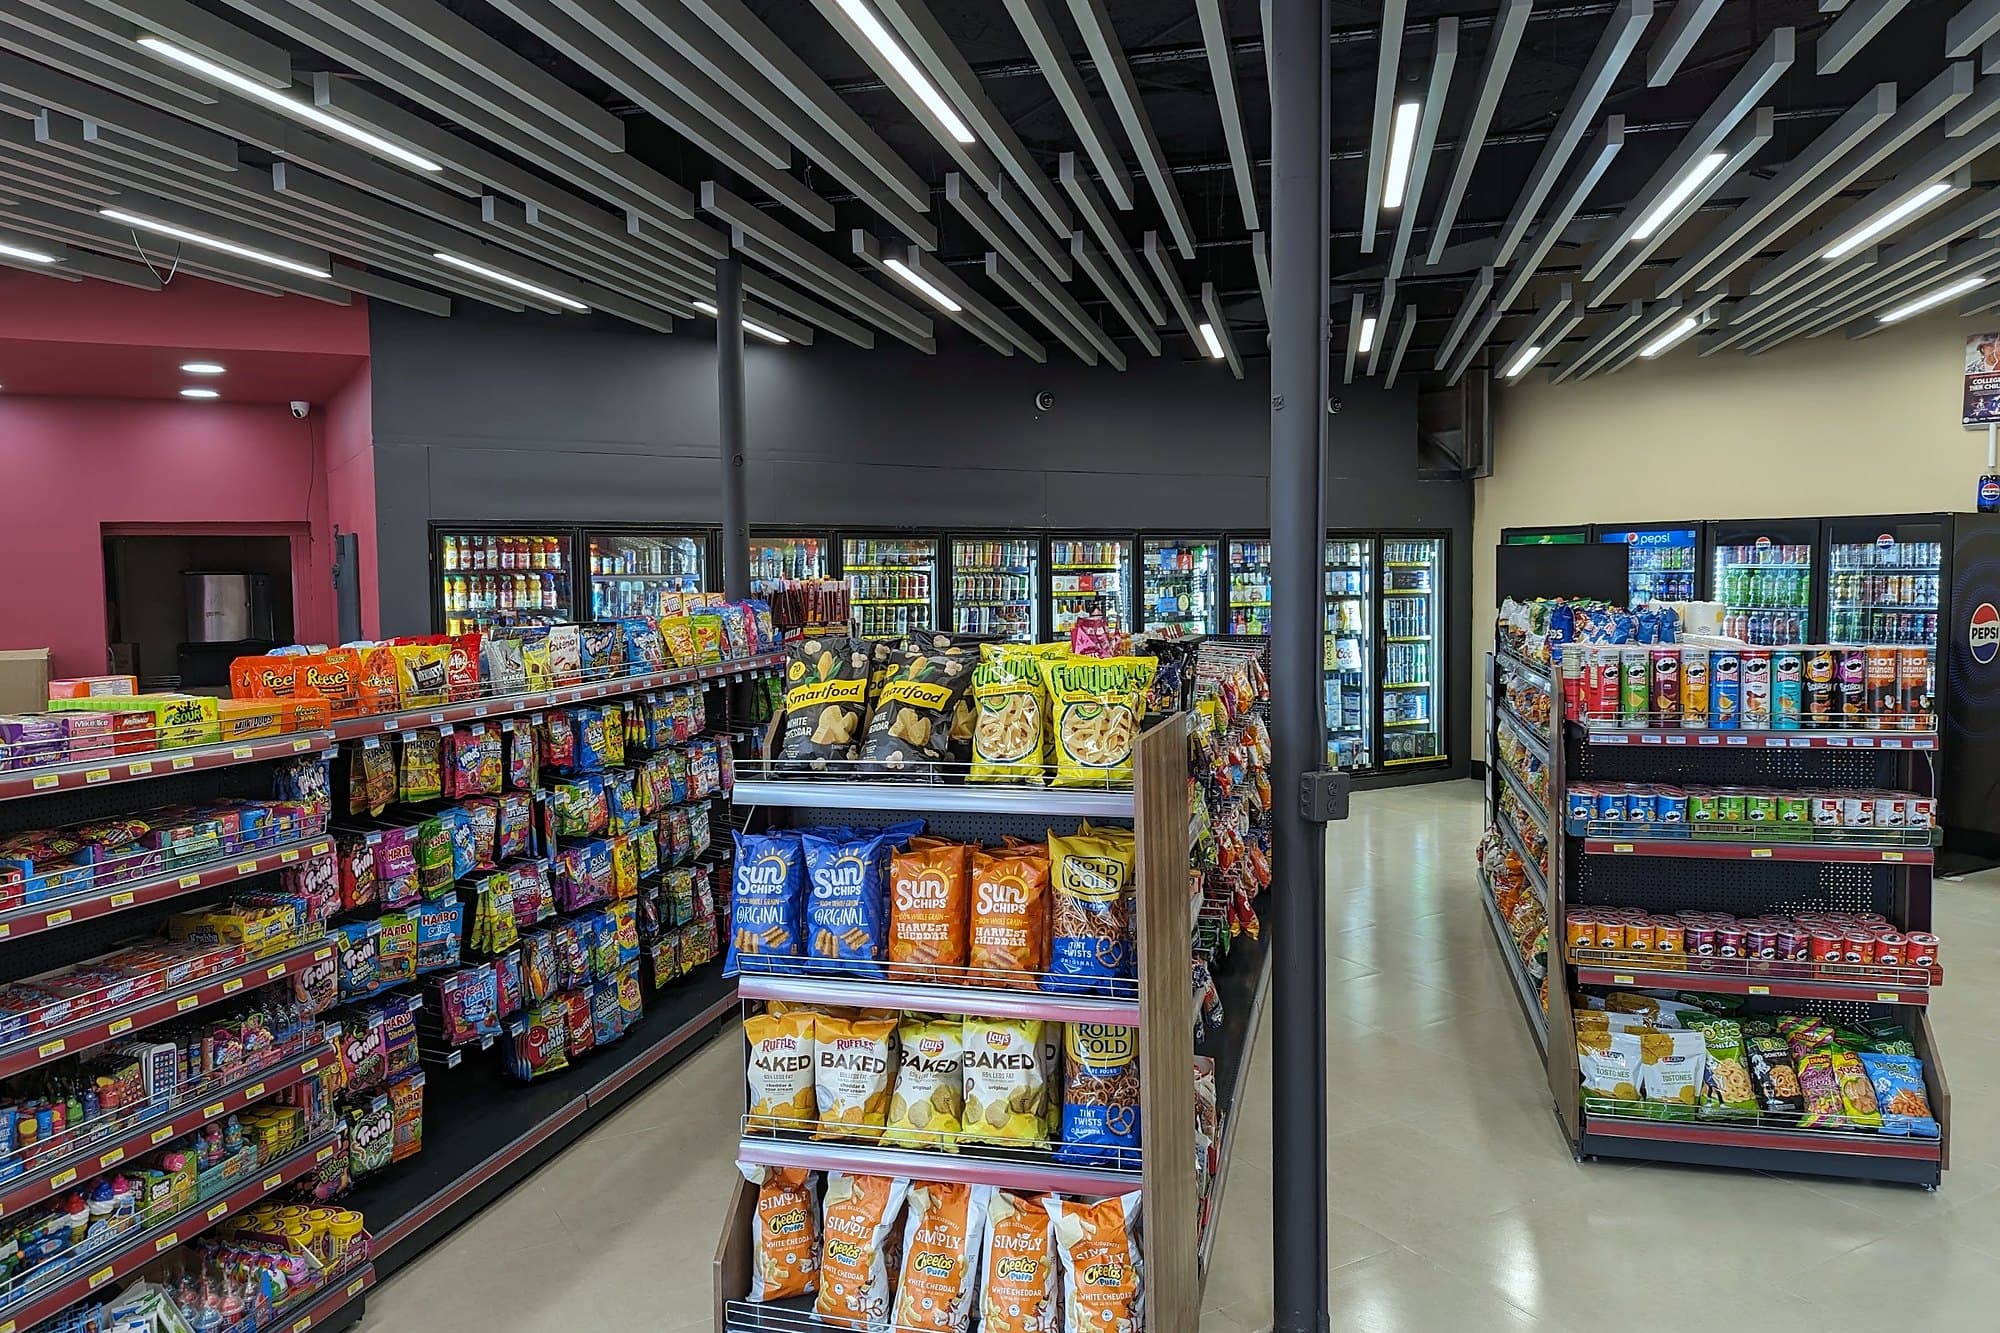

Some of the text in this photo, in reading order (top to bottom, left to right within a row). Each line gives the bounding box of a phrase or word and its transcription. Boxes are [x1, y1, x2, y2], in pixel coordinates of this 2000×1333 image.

[1641, 532, 1670, 545] pepsi
[1972, 627, 1999, 640] PEPSI
[788, 684, 860, 709] Smartfood
[174, 711, 201, 724] SOUR
[737, 864, 787, 895] Sun
[814, 866, 864, 898] Sun
[1069, 874, 1118, 890] GOLD
[750, 884, 782, 895] CHIPS
[833, 885, 861, 896] CHIPS
[896, 879, 950, 911] Sun
[912, 899, 946, 909] CHIPS
[976, 882, 1028, 915] Sun
[993, 903, 1026, 914] CHIPS
[422, 911, 458, 926] HARIBO
[736, 907, 788, 925] ORIGINAL
[814, 908, 868, 926] ORIGINAL
[381, 923, 414, 938] HARIBO
[897, 923, 949, 932] HARVEST
[975, 927, 1027, 938] HARVEST
[897, 931, 948, 941] CHEDDAR
[975, 937, 1026, 947] CHEDDAR
[1064, 949, 1092, 958] TWISTS
[1079, 1023, 1127, 1037] ROLD
[348, 1028, 380, 1062] Trolli
[762, 1038, 797, 1052] RUFFLES
[836, 1038, 875, 1051] RUFFLES
[1082, 1039, 1127, 1054] GOLD
[756, 1055, 811, 1072] AKED
[821, 1052, 886, 1074] BAKED
[963, 1050, 1035, 1070] BAKED
[1080, 1109, 1095, 1117] TINY
[1074, 1116, 1102, 1126] TWISTS
[768, 1209, 807, 1234] Cheetos
[766, 1236, 810, 1249] WHITE CHEDDA
[916, 1228, 961, 1249] SIMPLY
[995, 1234, 1043, 1252] SIMPLY
[828, 1240, 861, 1260] Cheetos
[915, 1252, 954, 1272] Cheetos
[998, 1257, 1038, 1277] Cheetos
[838, 1268, 864, 1281] CHEDDAR
[1084, 1264, 1122, 1285] Cheetos
[925, 1281, 956, 1292] CHEDDAR
[992, 1286, 1041, 1297] WHITE CHEDDAR
[1080, 1292, 1101, 1301] WHITE
